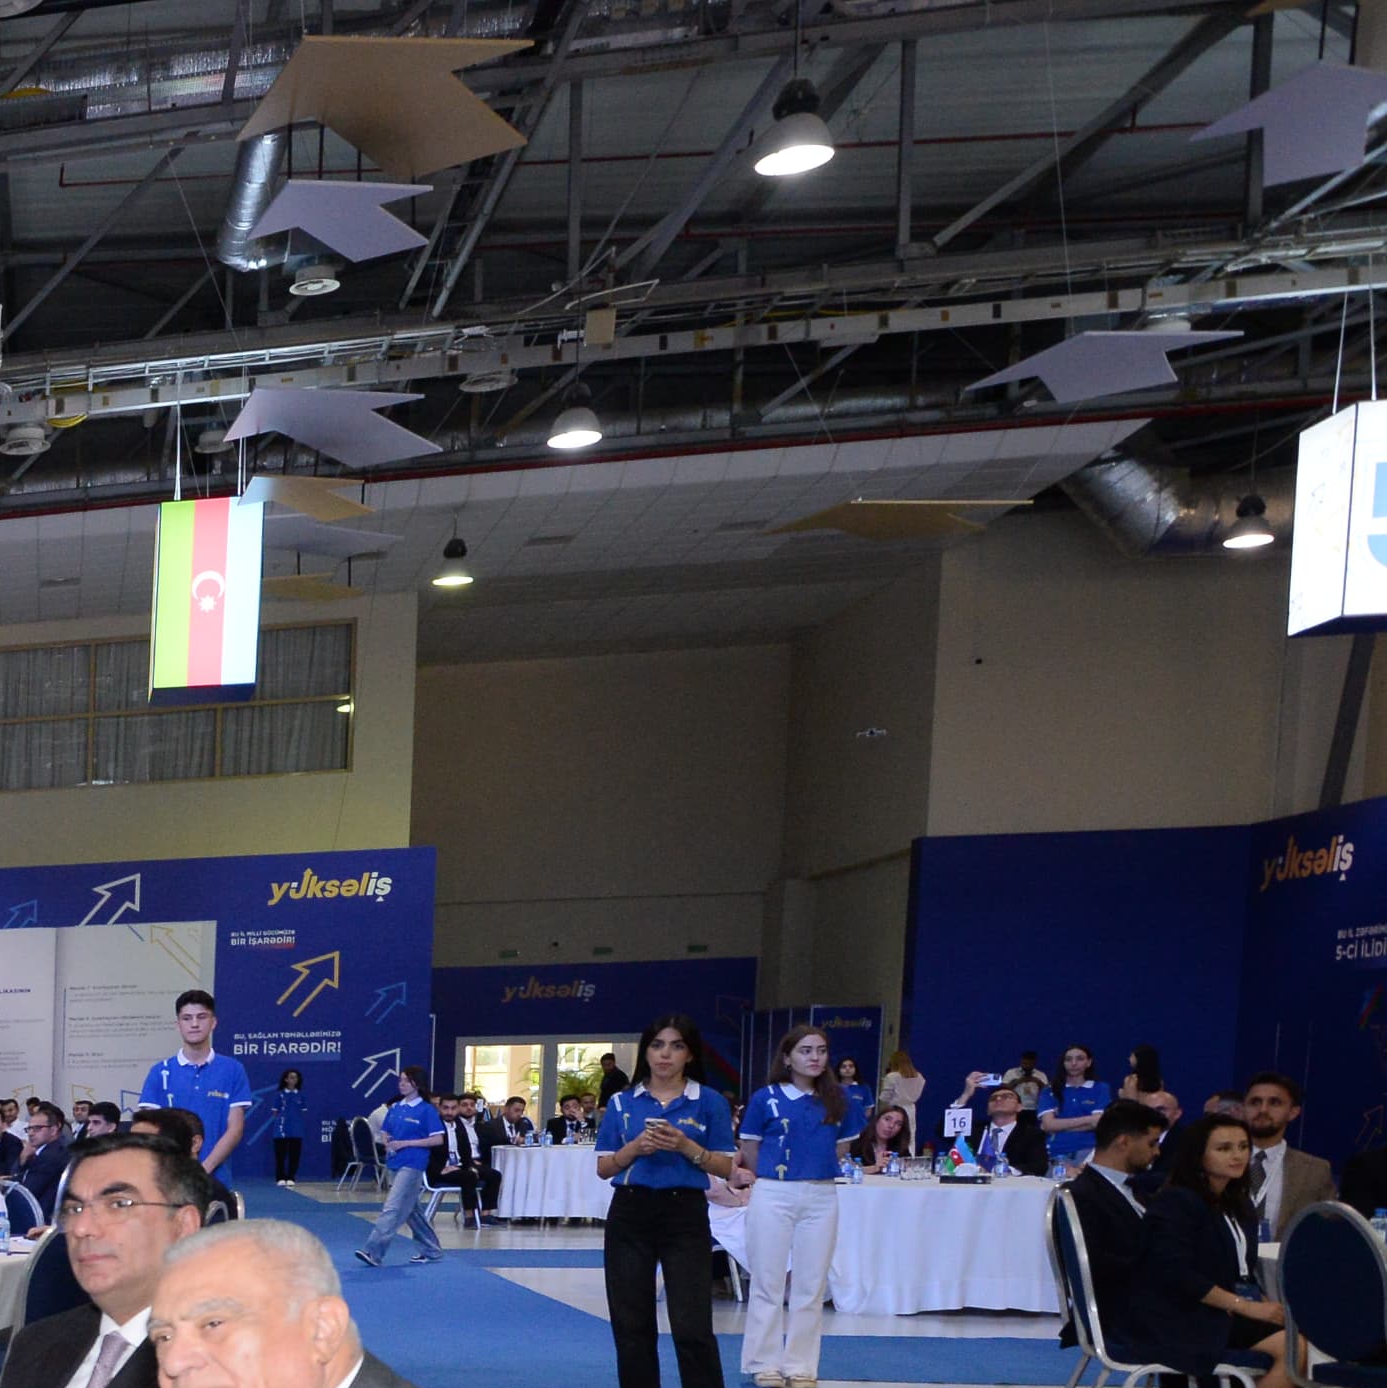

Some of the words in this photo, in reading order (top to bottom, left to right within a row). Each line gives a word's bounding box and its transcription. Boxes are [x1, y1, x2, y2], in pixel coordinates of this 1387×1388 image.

[267, 867, 393, 906] yüksəliş
[231, 937, 246, 946] BİR
[233, 1040, 259, 1055] BİR
[263, 1039, 341, 1056] İŞARƏDİR!
[951, 1117, 967, 1128] 16
